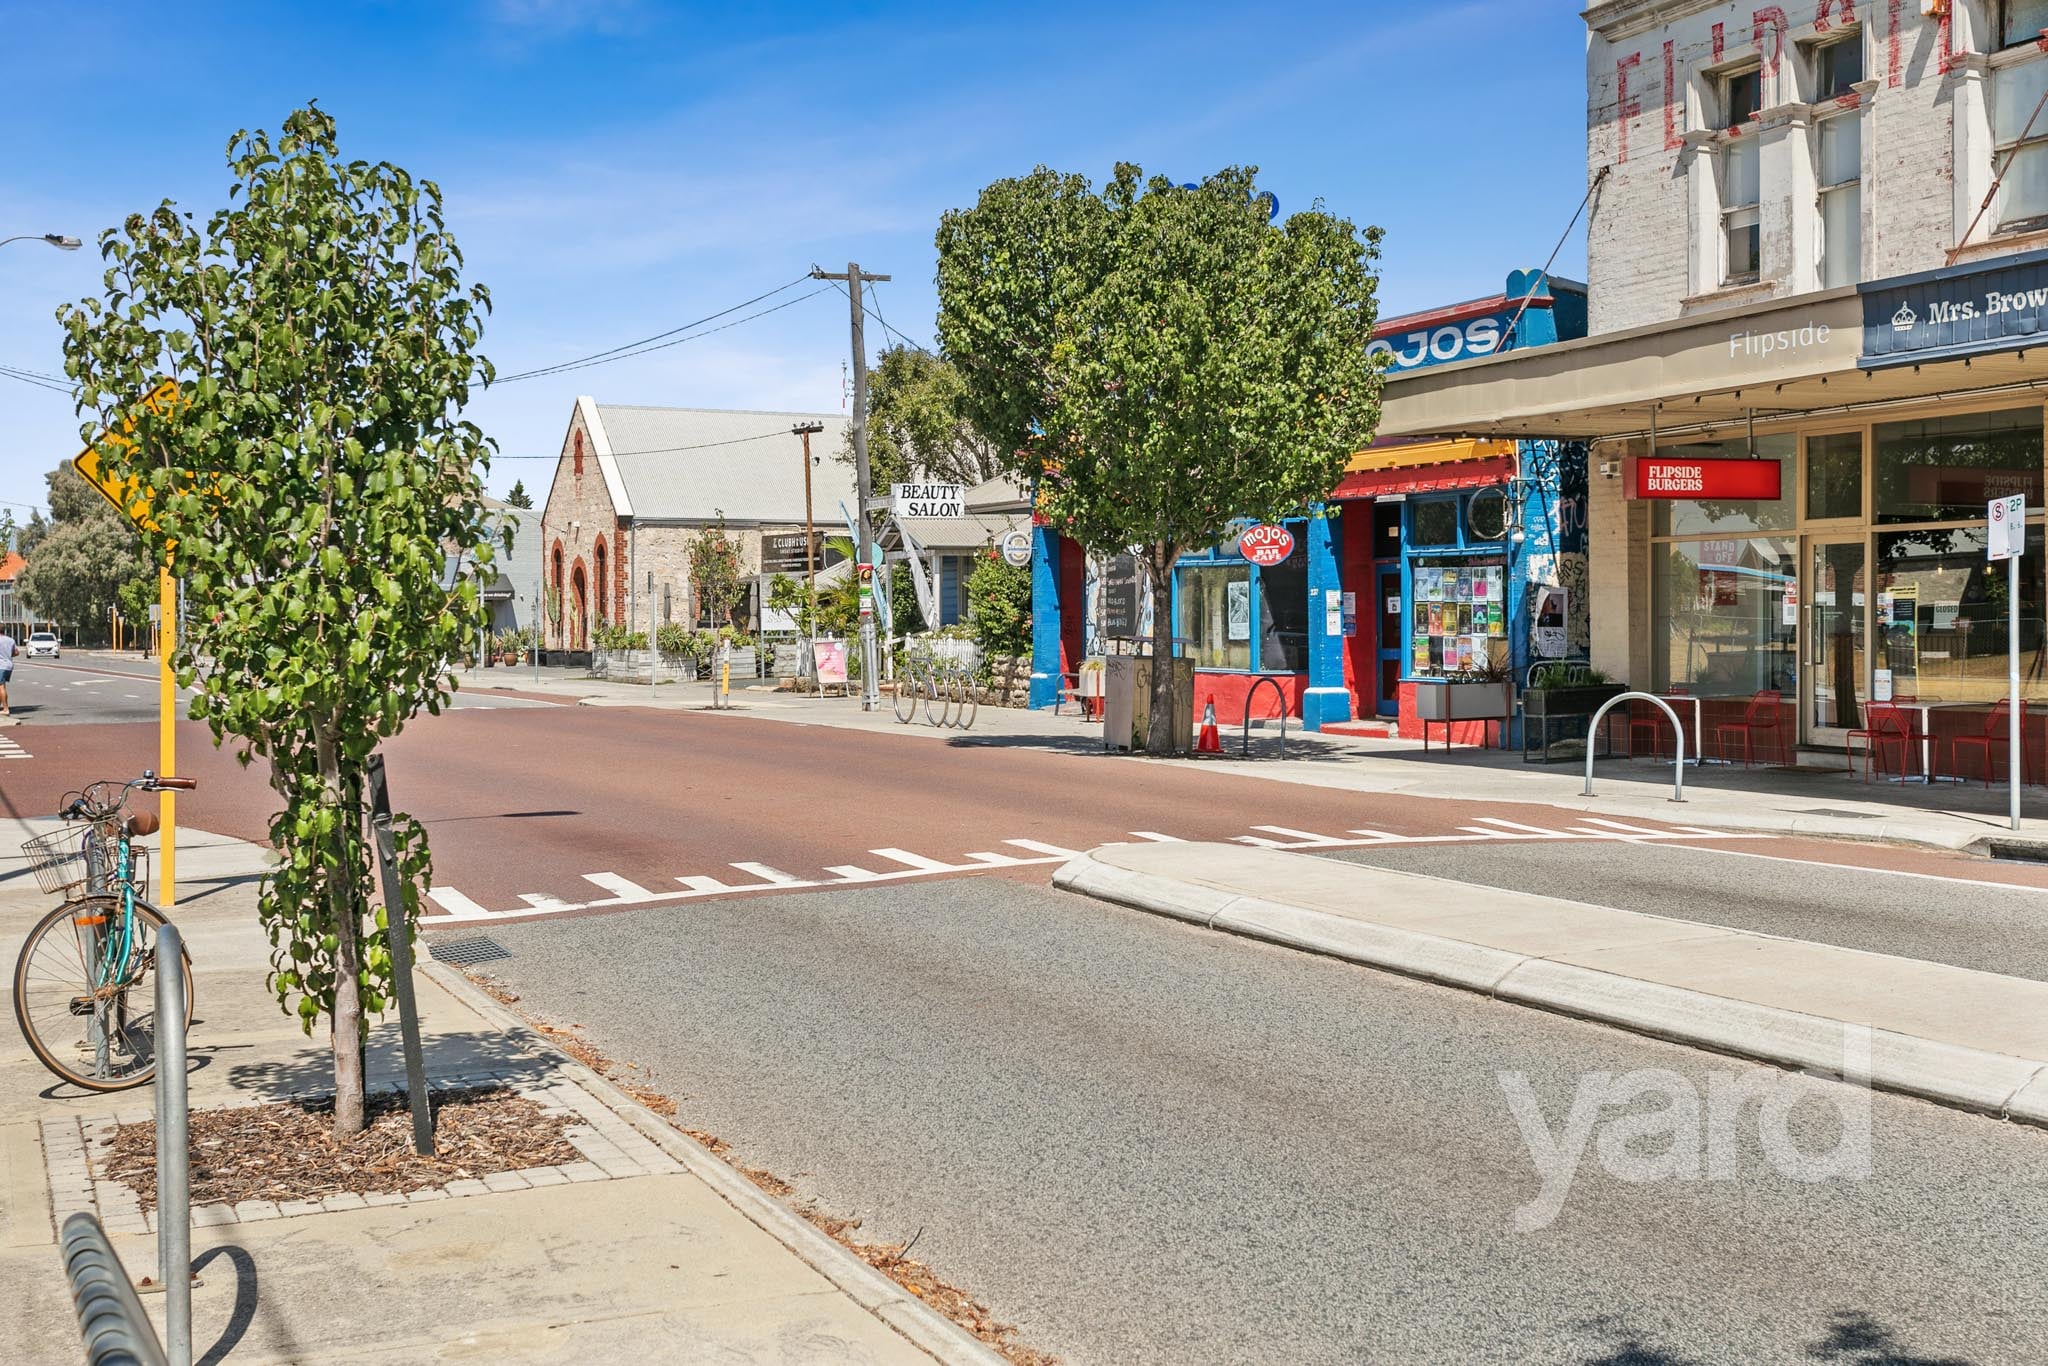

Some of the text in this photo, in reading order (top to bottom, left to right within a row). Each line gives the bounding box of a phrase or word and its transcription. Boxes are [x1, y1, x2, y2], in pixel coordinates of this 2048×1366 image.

[1928, 300, 1981, 325] Mrs.
[1363, 317, 1501, 371] OJOS
[1728, 320, 1831, 359] Flipside
[1648, 465, 1702, 479] FLIPSIDE
[901, 484, 960, 500] BEAUTY
[1647, 478, 1703, 492] BURGERS
[908, 502, 960, 517] SALON
[2009, 498, 2022, 513] 2P
[1255, 548, 1279, 556] BAR
[1703, 541, 1735, 553] STAND
[1252, 553, 1282, 562] CAFE
[1715, 552, 1734, 563] OFF
[1935, 604, 1959, 614] CLOSED
